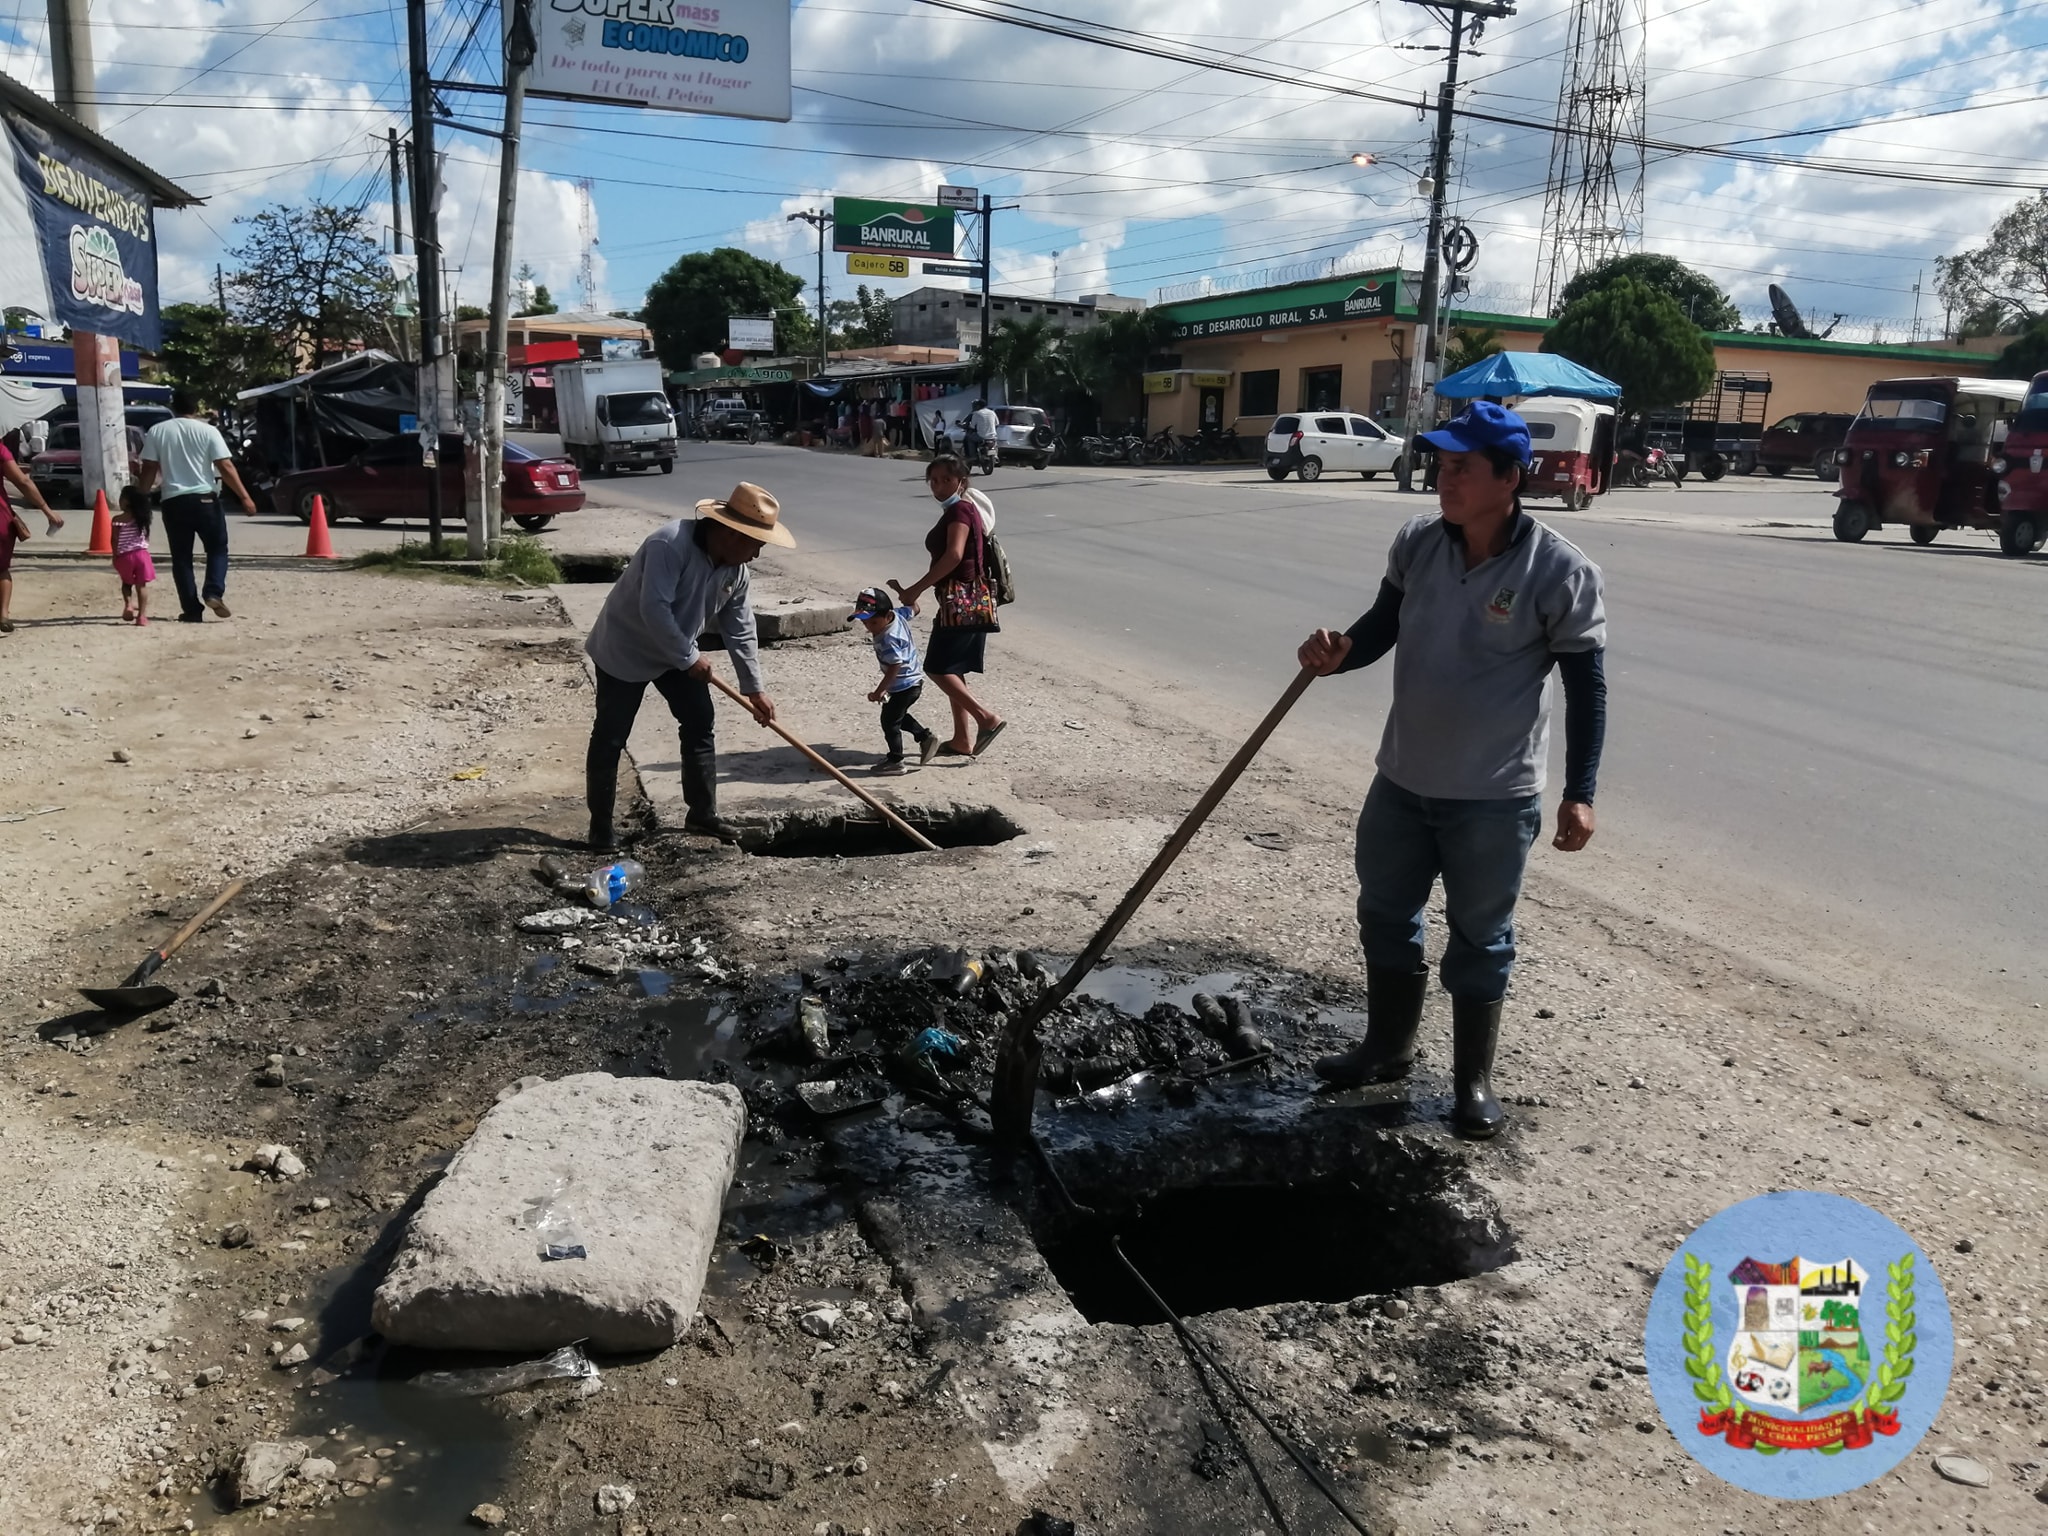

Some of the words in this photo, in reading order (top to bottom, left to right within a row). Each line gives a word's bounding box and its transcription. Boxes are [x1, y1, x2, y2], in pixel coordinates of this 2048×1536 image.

[676, 4, 720, 23] mass
[602, 19, 749, 64] ECONOMICO
[552, 55, 576, 69] De
[581, 60, 620, 75] todo
[624, 66, 667, 81] para
[672, 73, 692, 83] su
[697, 71, 751, 90] Hogar
[592, 79, 610, 94] El
[37, 152, 149, 242] BIENVENIDOS
[861, 226, 931, 245] BANRURAL
[71, 227, 126, 309] SUPER
[854, 259, 885, 269] Cajero
[888, 261, 904, 272] 5B
[1344, 296, 1382, 312] BANRURAL
[1193, 323, 1203, 336] DE
[1209, 315, 1263, 333] DESARROLLO
[1269, 311, 1302, 326] RURAL,
[1309, 308, 1328, 321] S.A.
[505, 375, 523, 399] ERIA
